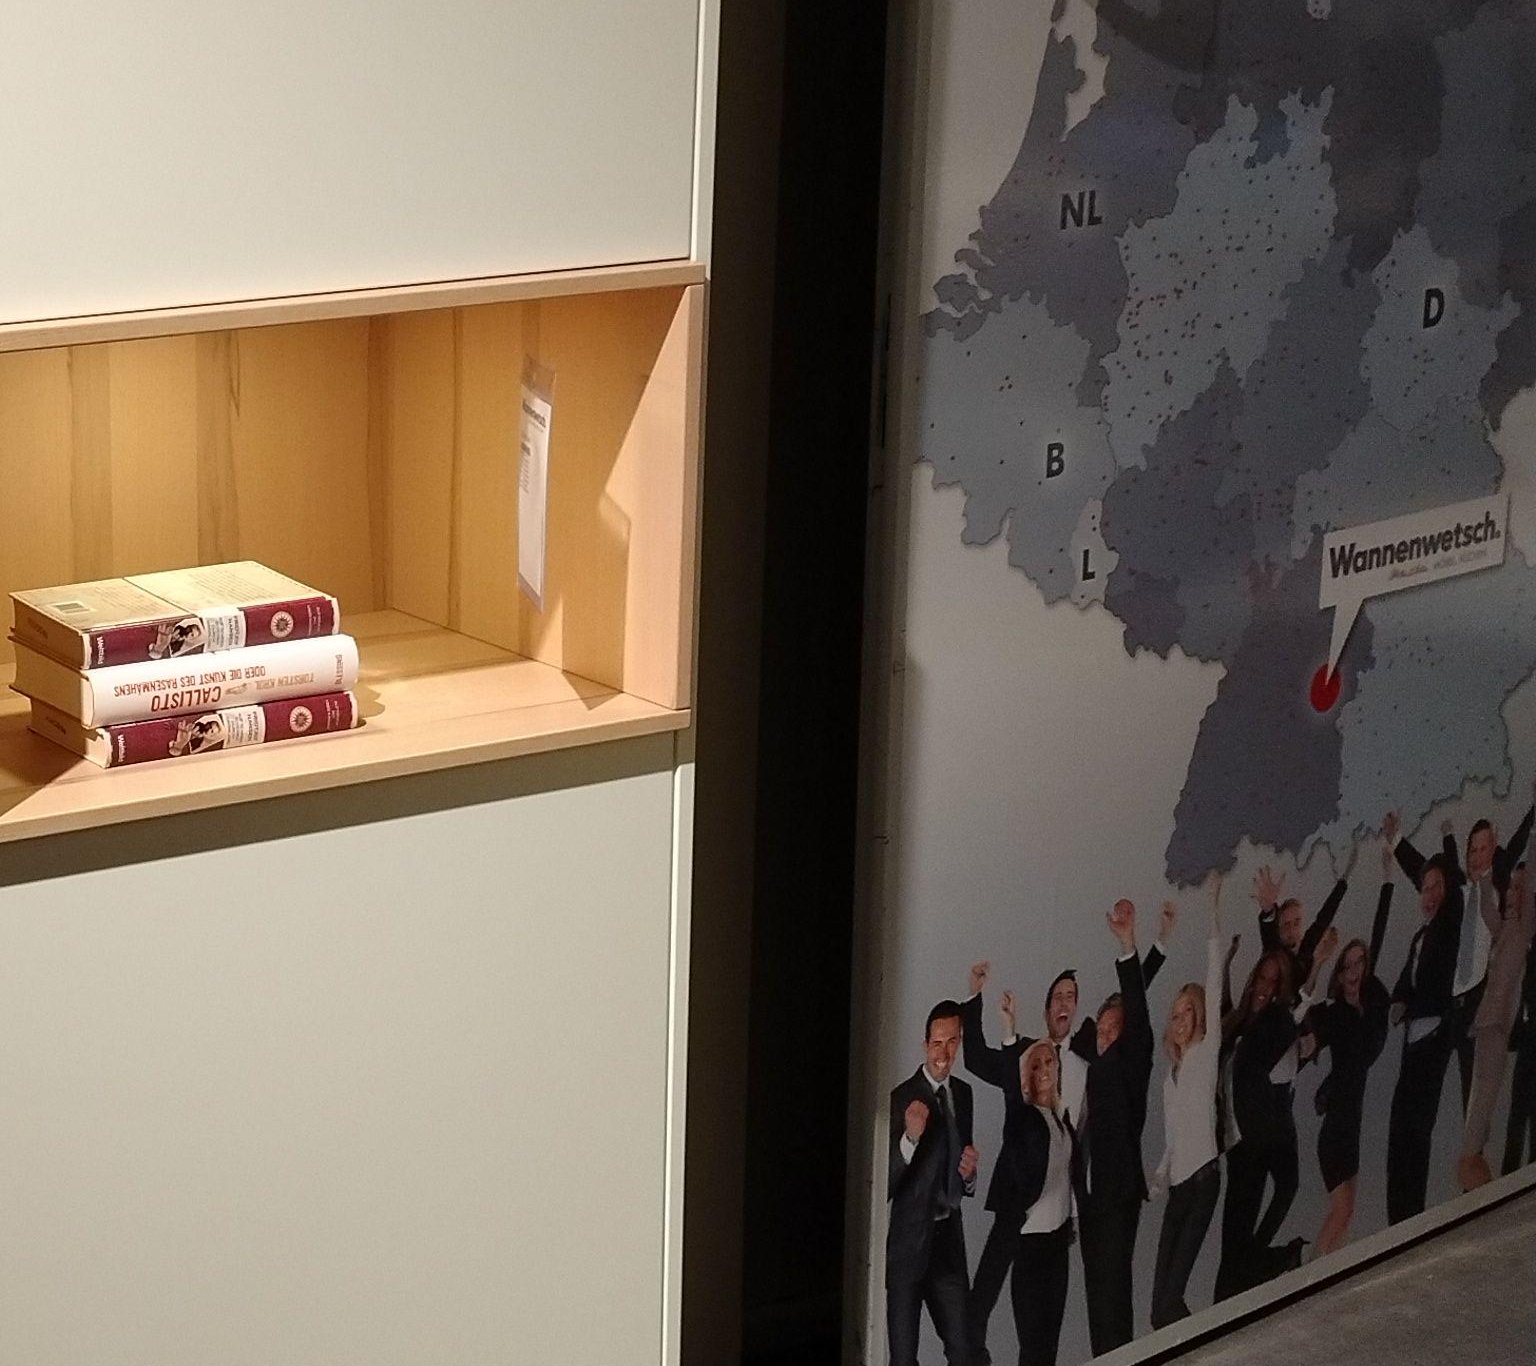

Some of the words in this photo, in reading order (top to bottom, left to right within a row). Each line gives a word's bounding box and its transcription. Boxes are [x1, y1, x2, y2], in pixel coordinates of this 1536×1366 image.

[1058, 189, 1104, 233] NL
[1422, 286, 1446, 330] D
[1044, 442, 1066, 479] B
[1329, 510, 1502, 579] Wannenwetsch.
[1081, 548, 1096, 583] L
[179, 675, 196, 687] DES
[199, 670, 228, 686] KUNST
[228, 669, 242, 681] DIE
[244, 665, 266, 679] ODER
[150, 685, 222, 712] CALLISTO
